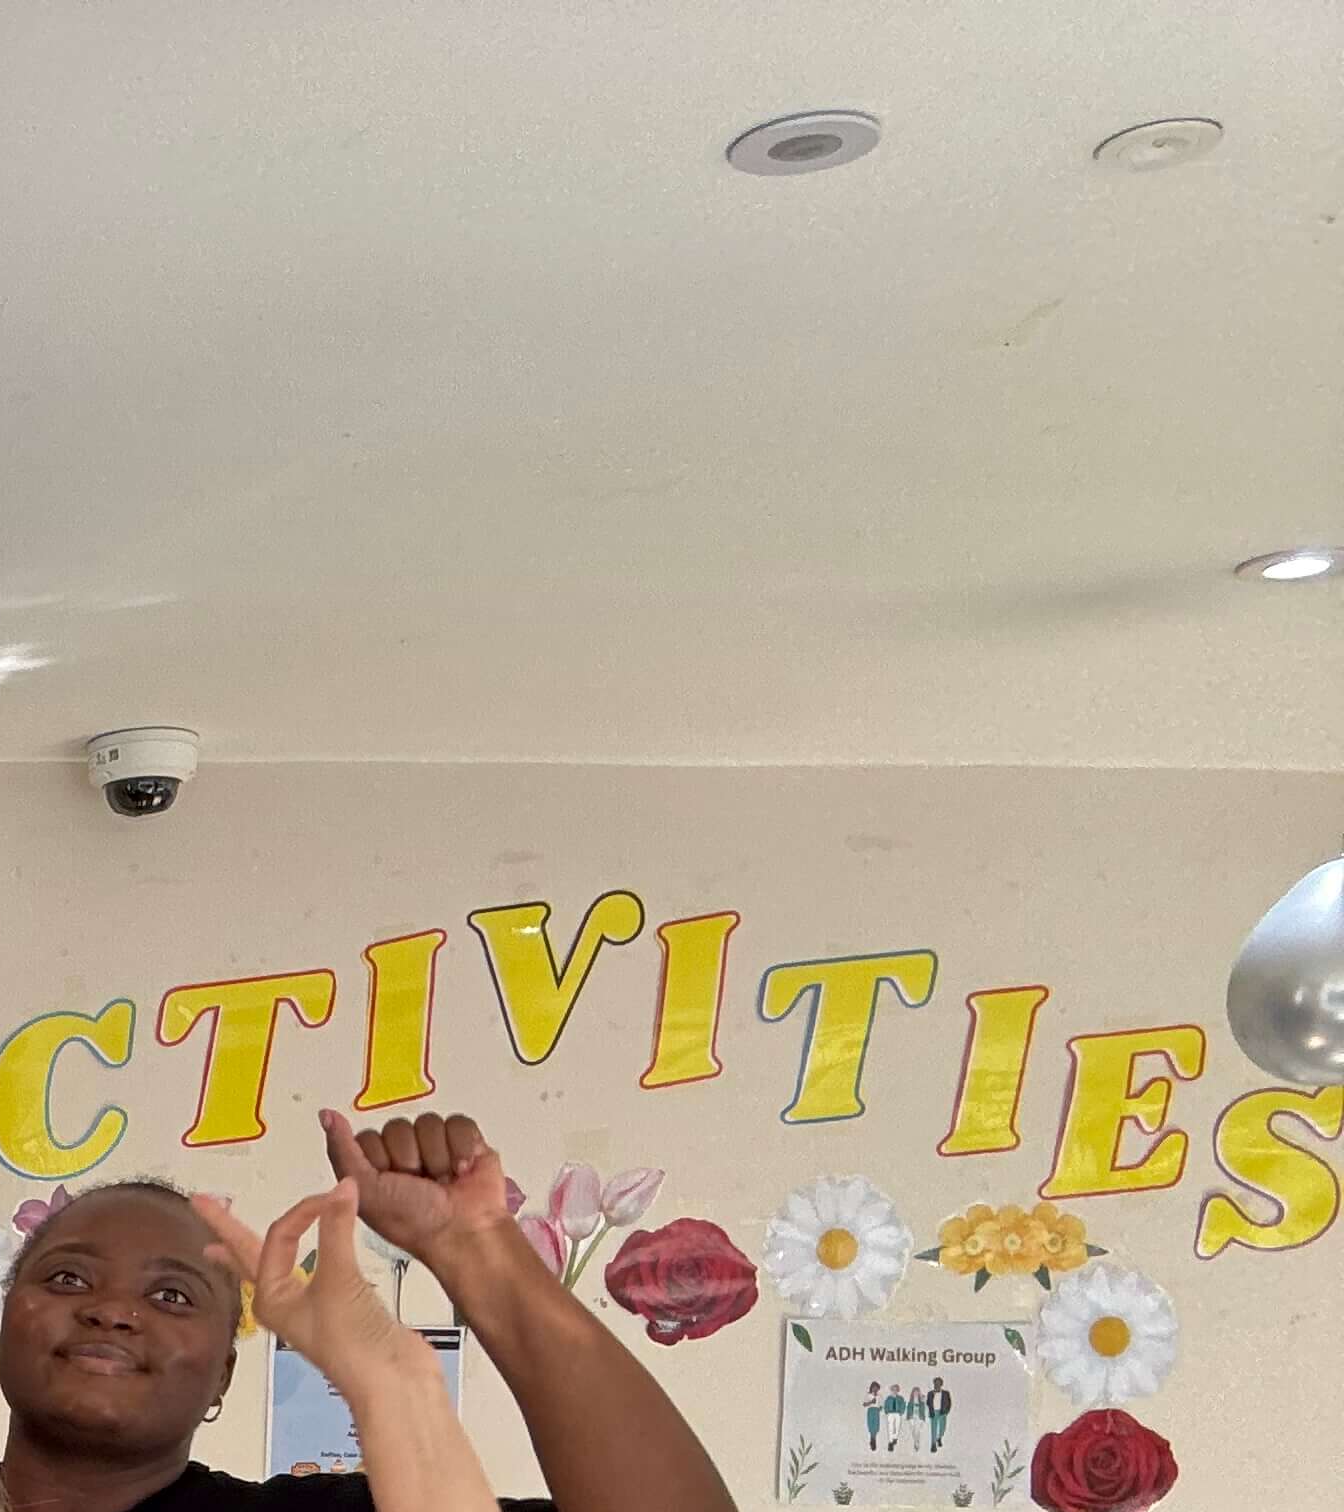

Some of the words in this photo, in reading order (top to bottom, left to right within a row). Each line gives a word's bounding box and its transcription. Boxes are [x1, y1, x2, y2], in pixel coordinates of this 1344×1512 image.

[825, 1346, 864, 1361] ADH
[870, 1348, 938, 1366] Walking
[942, 1349, 996, 1368] Group
